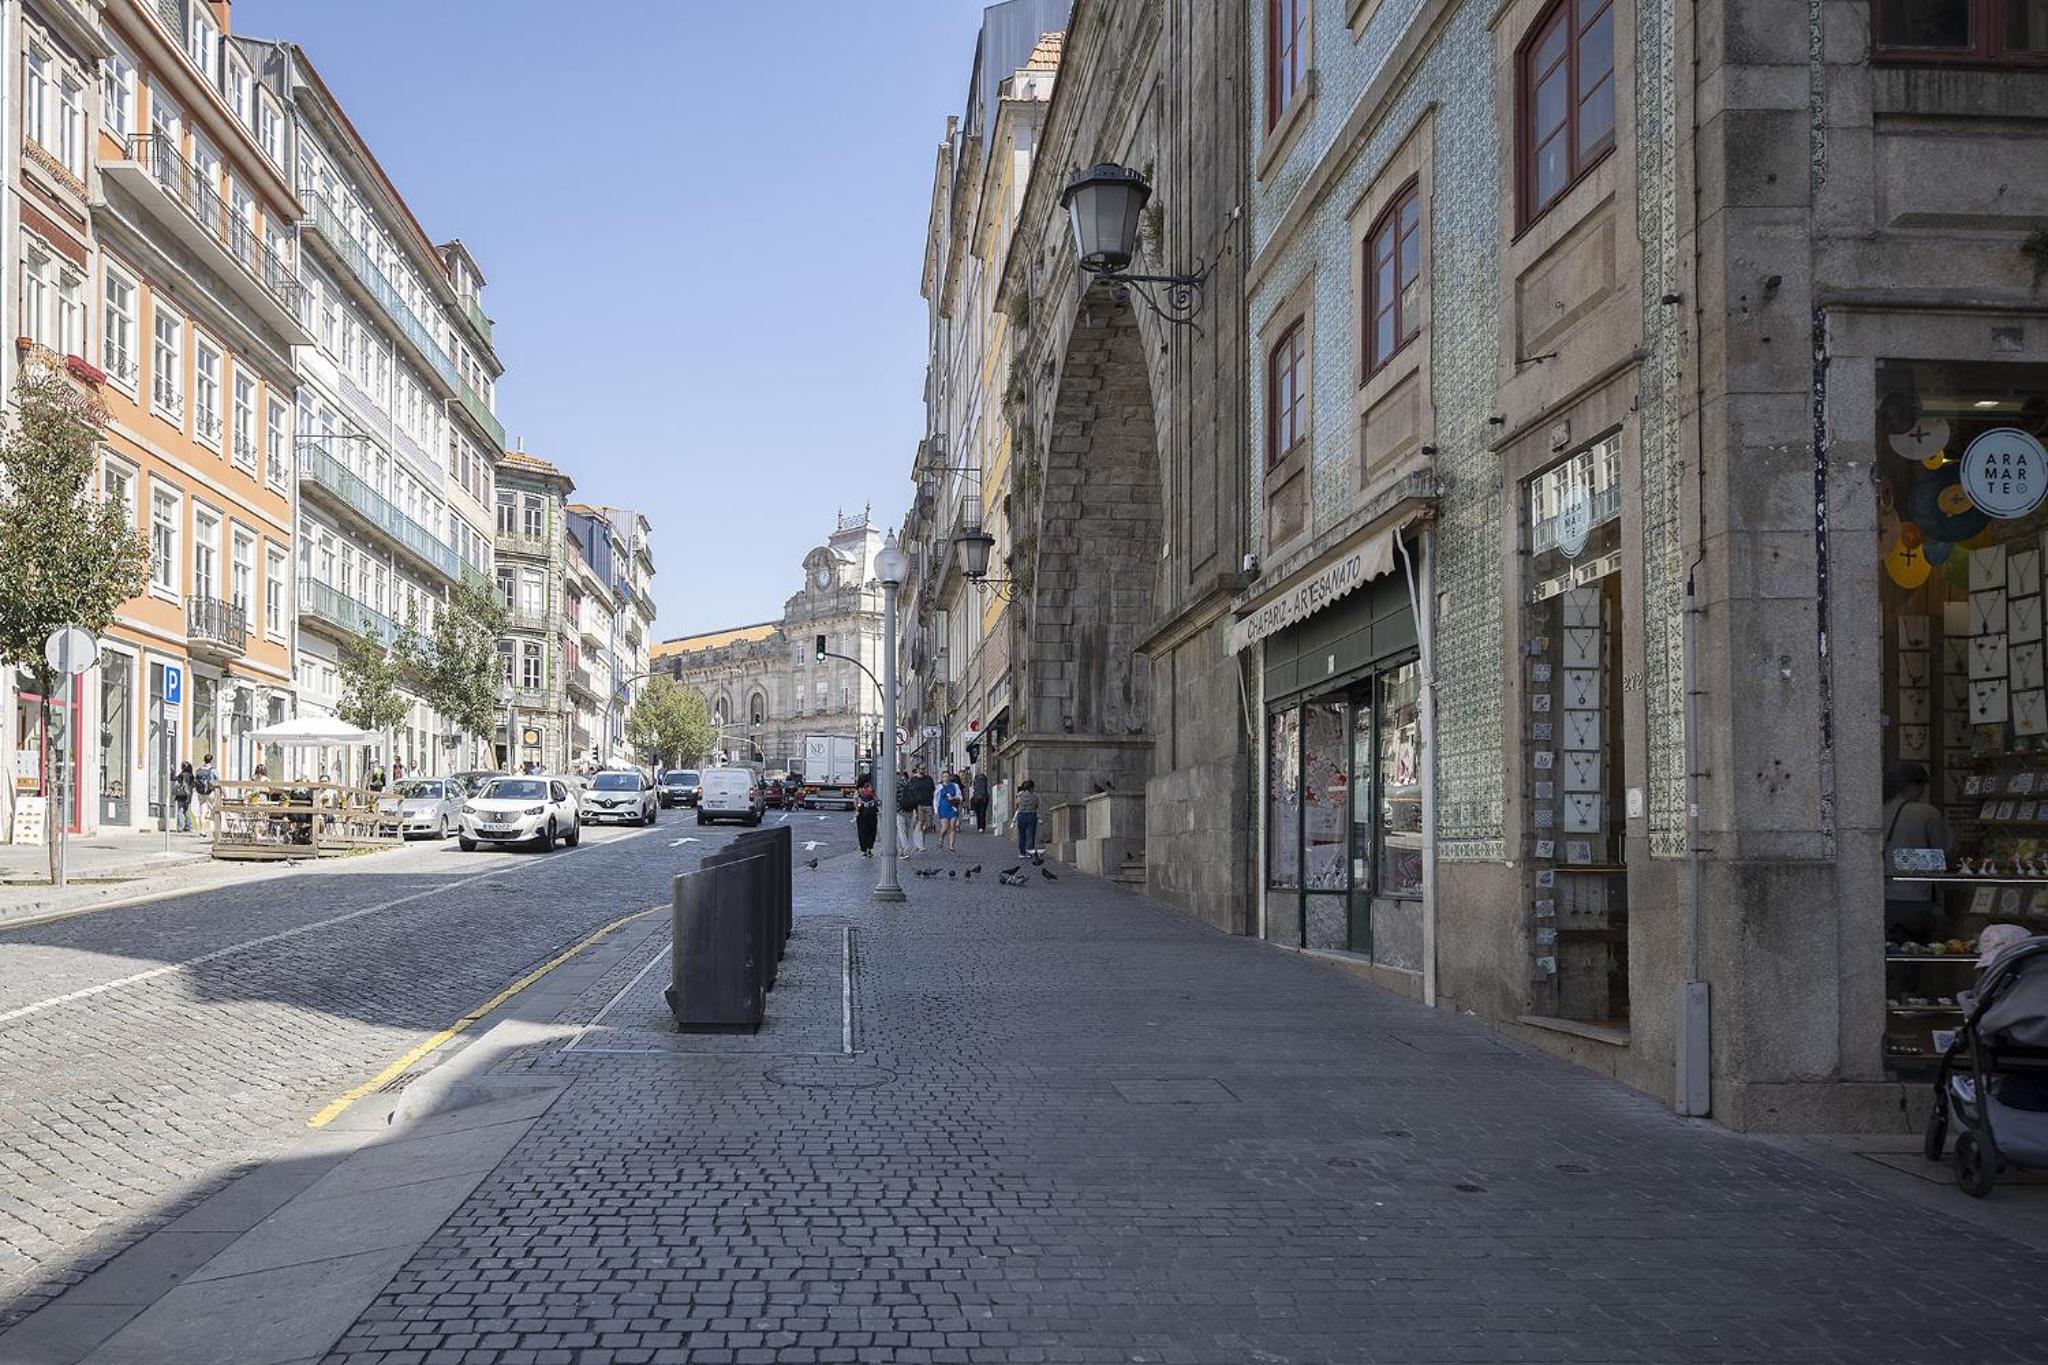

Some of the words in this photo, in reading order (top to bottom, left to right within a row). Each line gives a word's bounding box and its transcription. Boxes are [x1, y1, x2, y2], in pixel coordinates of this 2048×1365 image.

[1986, 453, 2027, 466] ARA
[1985, 468, 2026, 480] MAR
[1247, 600, 1287, 639] CHAFARIZ
[1294, 555, 1361, 614] ARTESANATO
[168, 670, 178, 699] P
